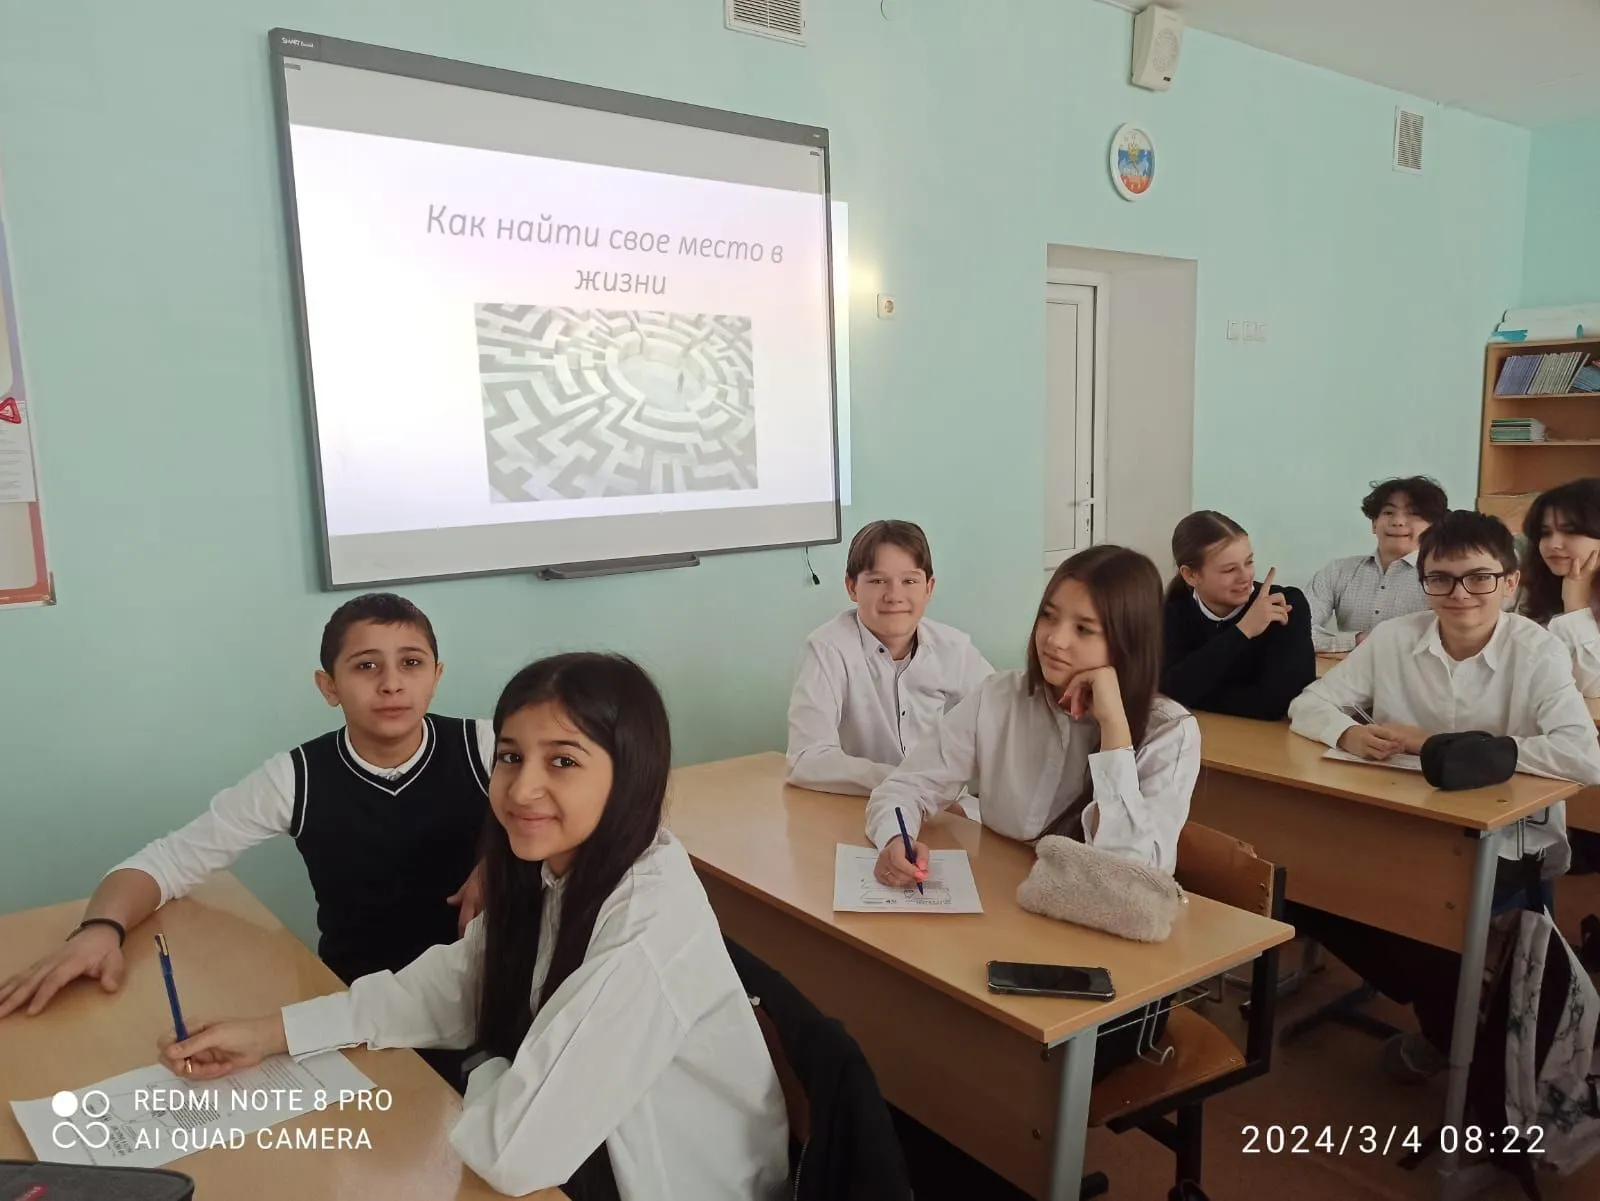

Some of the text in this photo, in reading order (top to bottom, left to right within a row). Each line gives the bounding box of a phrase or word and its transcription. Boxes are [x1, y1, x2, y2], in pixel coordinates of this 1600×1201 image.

[427, 204, 784, 264] Как найти свое место в
[574, 269, 667, 295] жизни
